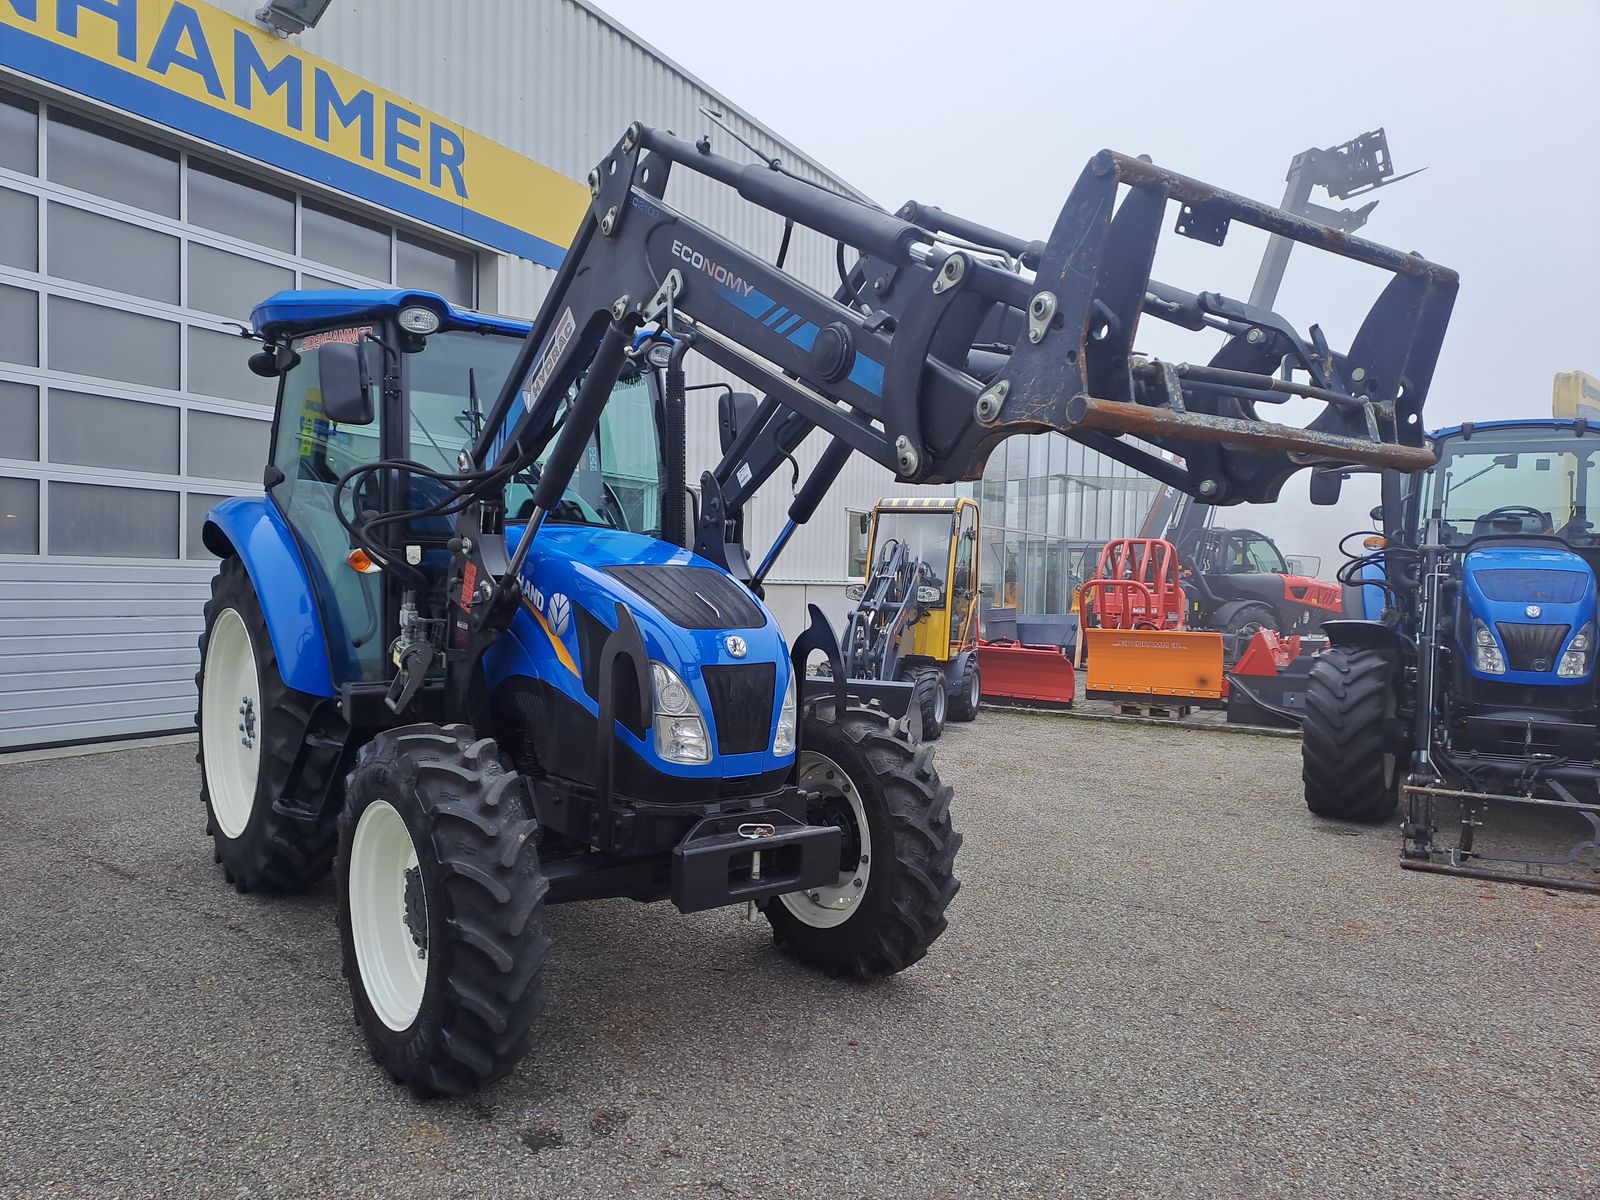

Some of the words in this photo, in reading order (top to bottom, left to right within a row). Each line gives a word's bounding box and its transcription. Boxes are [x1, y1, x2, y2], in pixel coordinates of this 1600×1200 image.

[0, 0, 469, 200] HAMMER
[671, 239, 754, 298] ECONOMY
[516, 572, 545, 612] LAND
